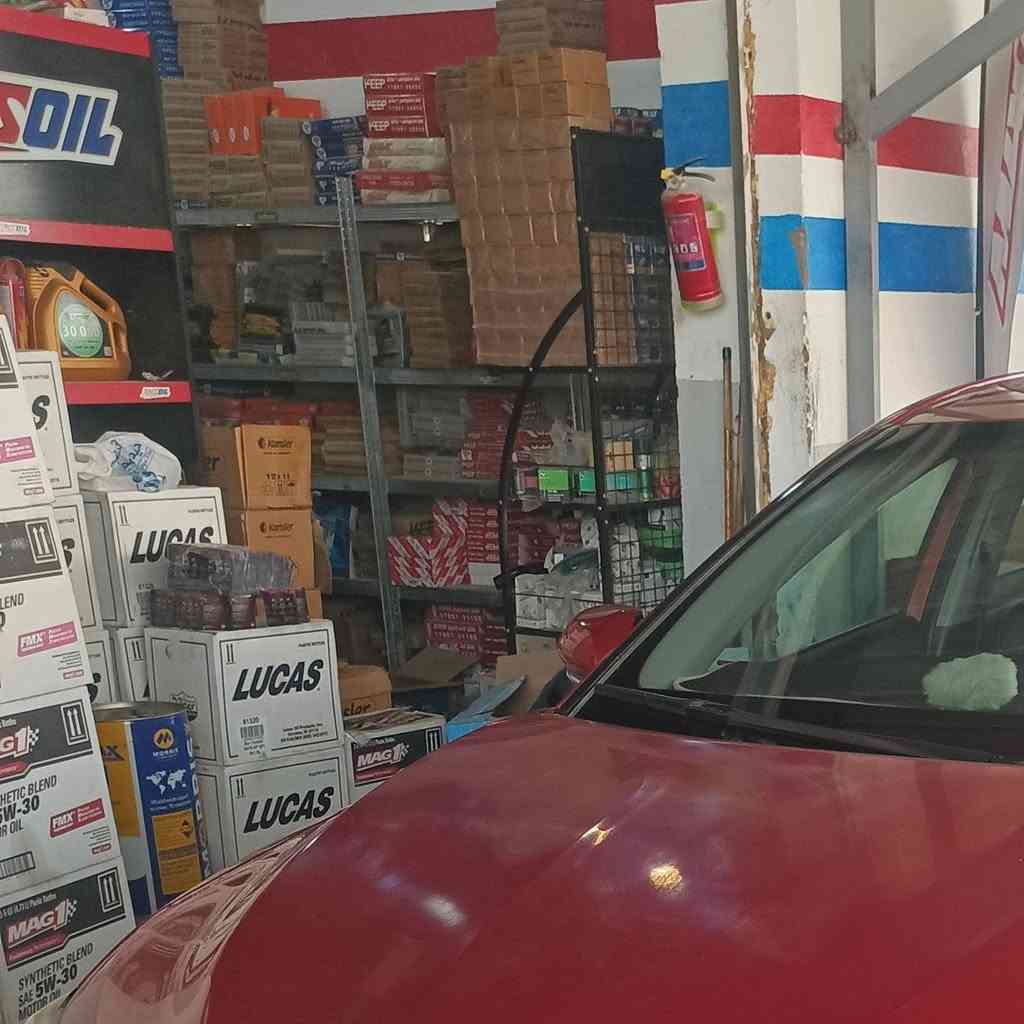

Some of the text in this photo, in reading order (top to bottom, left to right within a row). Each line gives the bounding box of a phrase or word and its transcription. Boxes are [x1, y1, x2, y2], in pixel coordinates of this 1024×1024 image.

[232, 659, 324, 702] LUCAS
[357, 743, 403, 768] MAG1
[28, 775, 57, 796] BLEND
[10, 820, 24, 834] OIL
[243, 787, 334, 833] LUCAS
[8, 898, 67, 944] MAG1
[18, 957, 65, 992] SYNTHETIC
[66, 942, 94, 966] BLEND
[18, 964, 78, 1007] SAE 5W-30
[17, 995, 48, 1021] MOTOR
